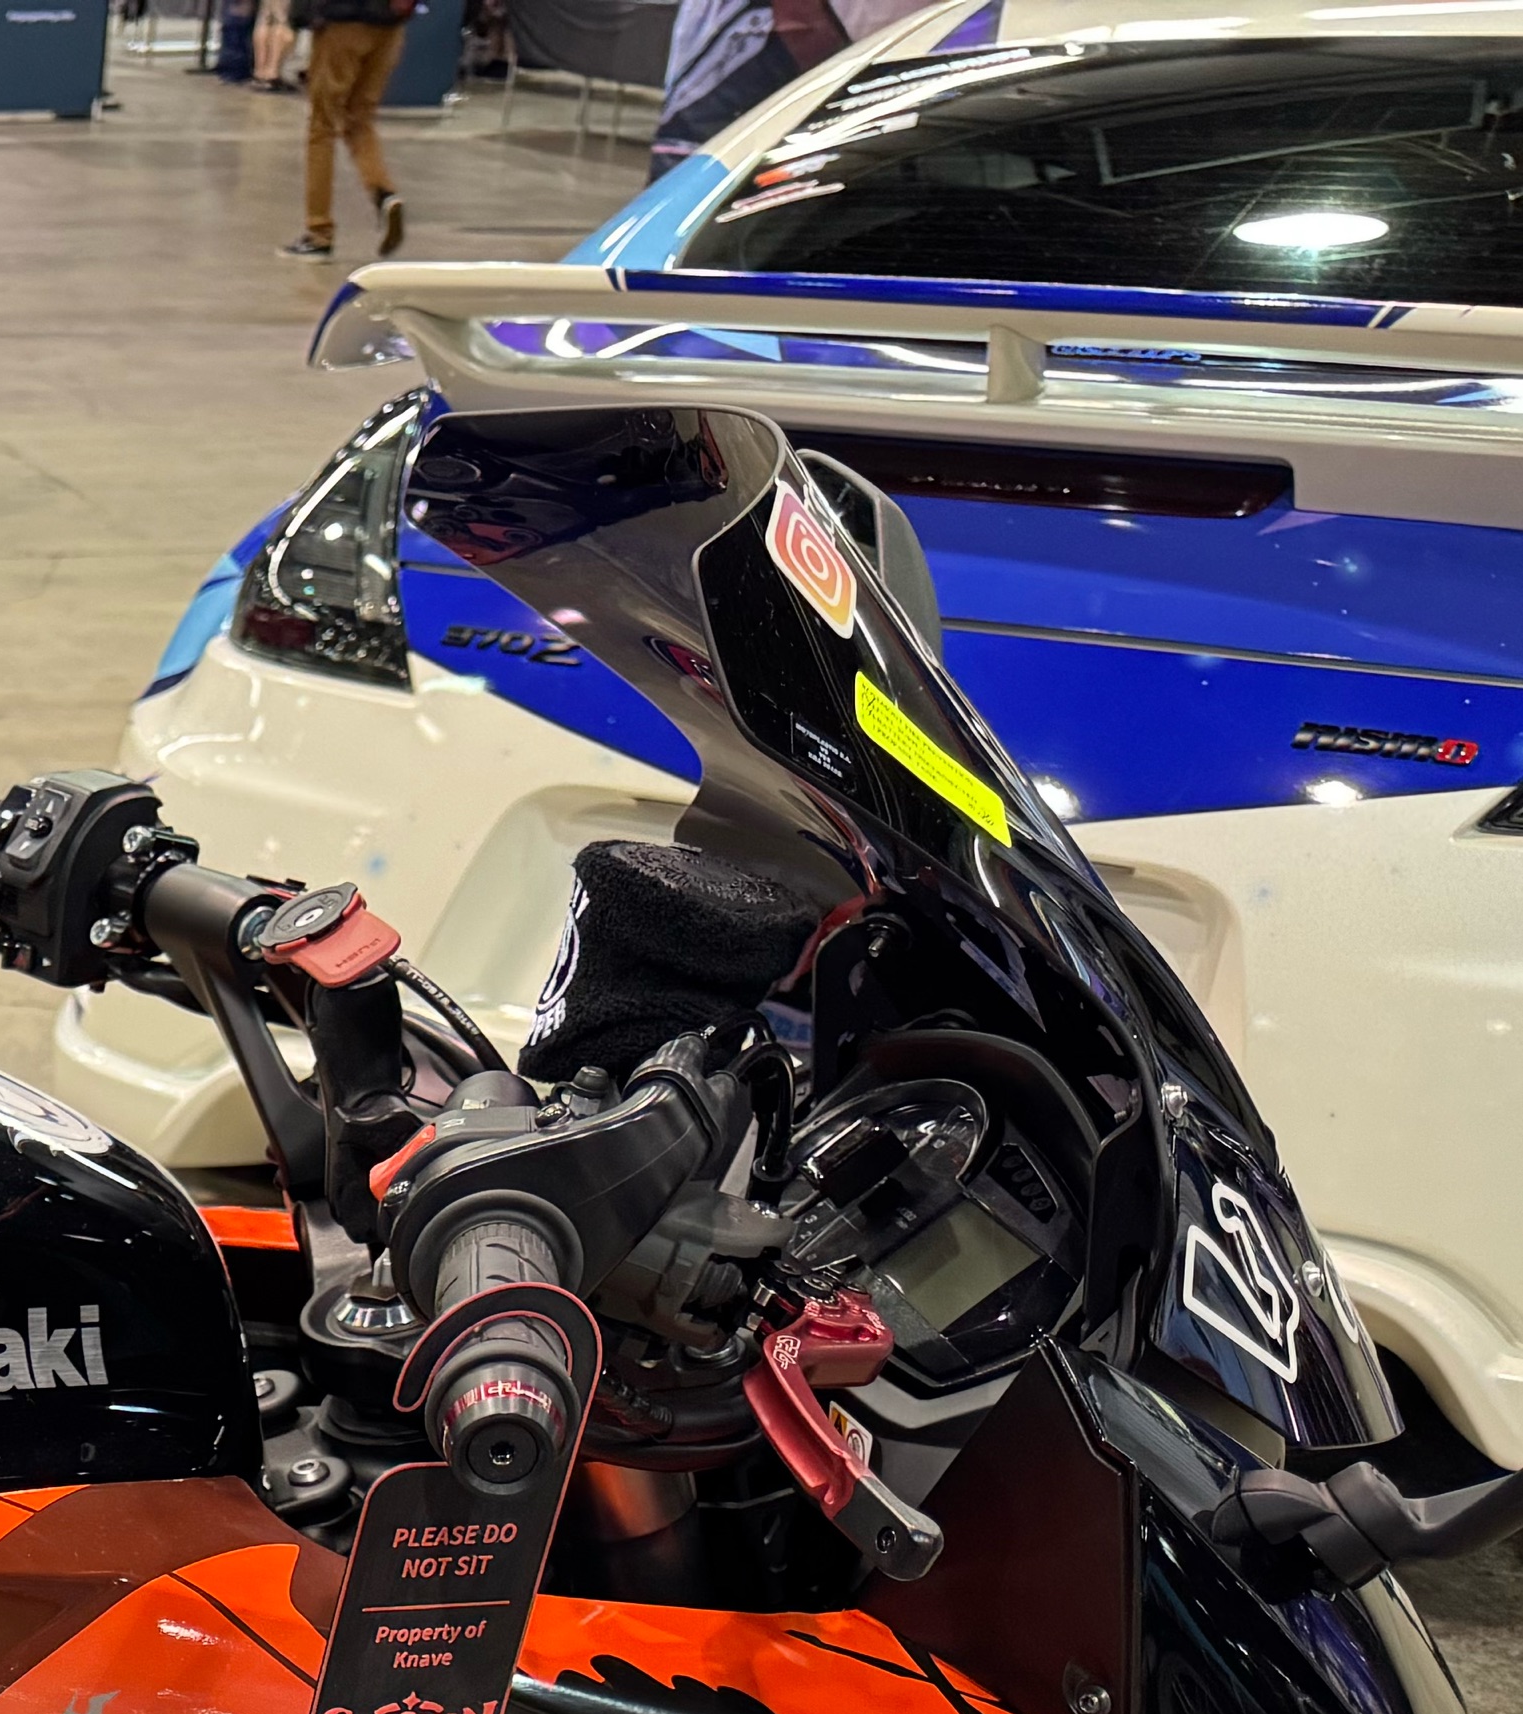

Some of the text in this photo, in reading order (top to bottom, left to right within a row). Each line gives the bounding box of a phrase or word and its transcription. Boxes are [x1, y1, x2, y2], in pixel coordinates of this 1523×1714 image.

[441, 625, 582, 666] 370Z
[391, 1522, 519, 1549] PLEASE DO
[401, 1554, 494, 1579] NOT SIT
[374, 1620, 488, 1647] Property of
[393, 1651, 454, 1669] Knave
